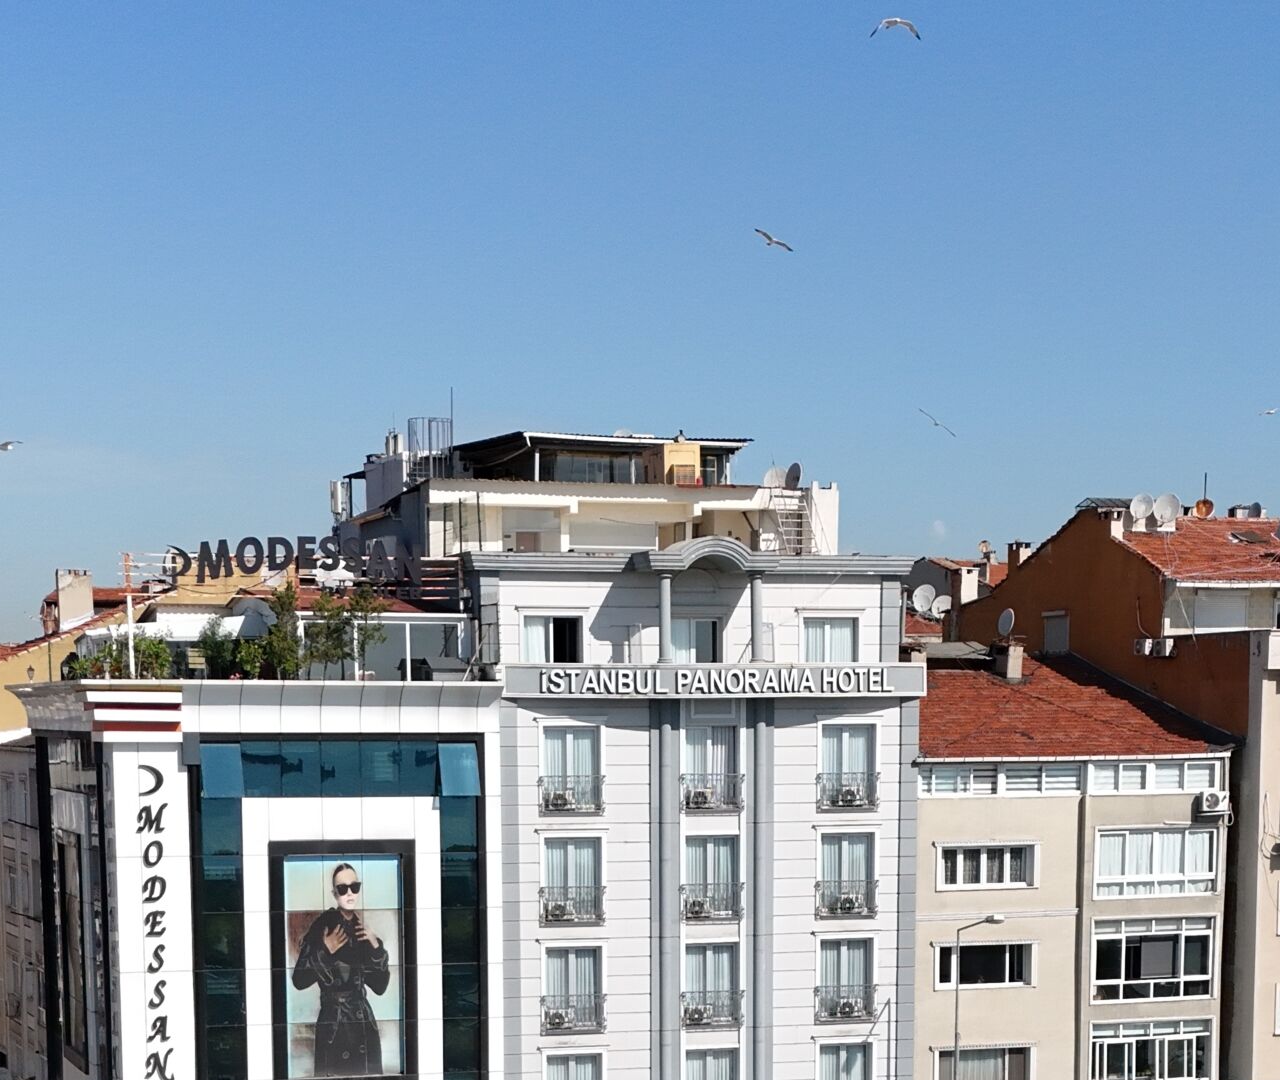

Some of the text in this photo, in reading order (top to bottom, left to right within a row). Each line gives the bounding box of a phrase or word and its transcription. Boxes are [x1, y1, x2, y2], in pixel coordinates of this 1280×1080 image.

[197, 536, 422, 585] MODESSAN
[541, 667, 895, 694] İSTANBUL PANORAMA HOTEL
